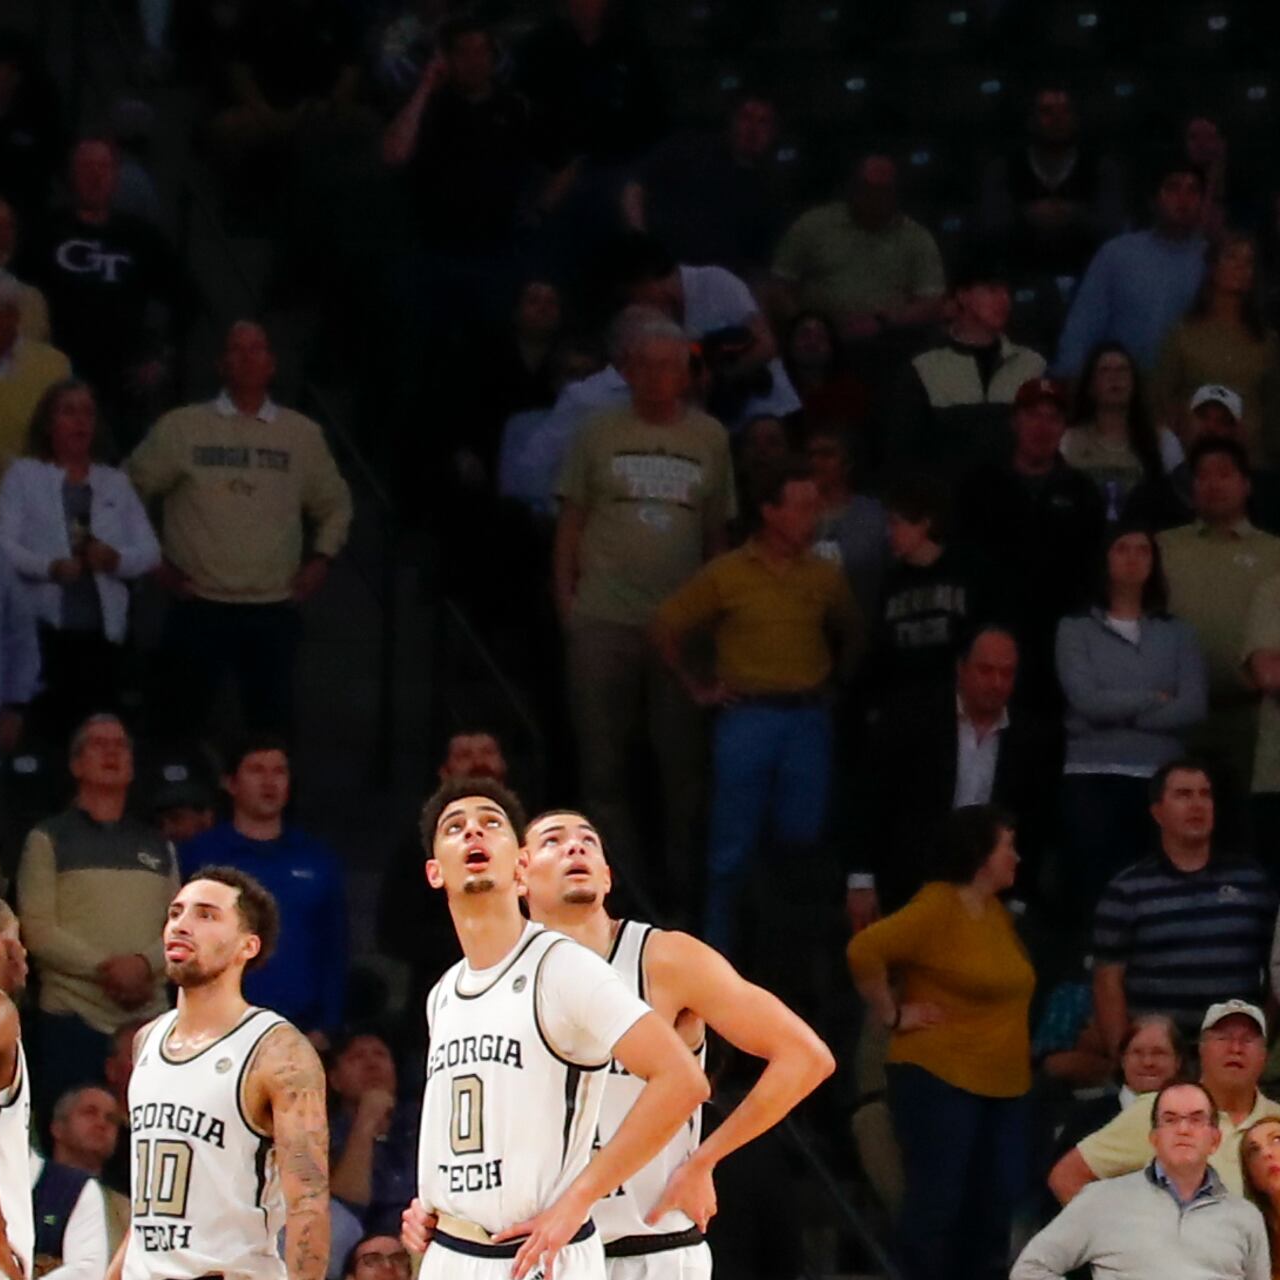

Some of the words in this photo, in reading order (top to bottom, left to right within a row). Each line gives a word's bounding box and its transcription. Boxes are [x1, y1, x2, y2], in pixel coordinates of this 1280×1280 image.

[56, 237, 133, 283] GT
[131, 1102, 225, 1149] EORGIA
[450, 1074, 484, 1156] 0
[134, 1139, 194, 1218] 10
